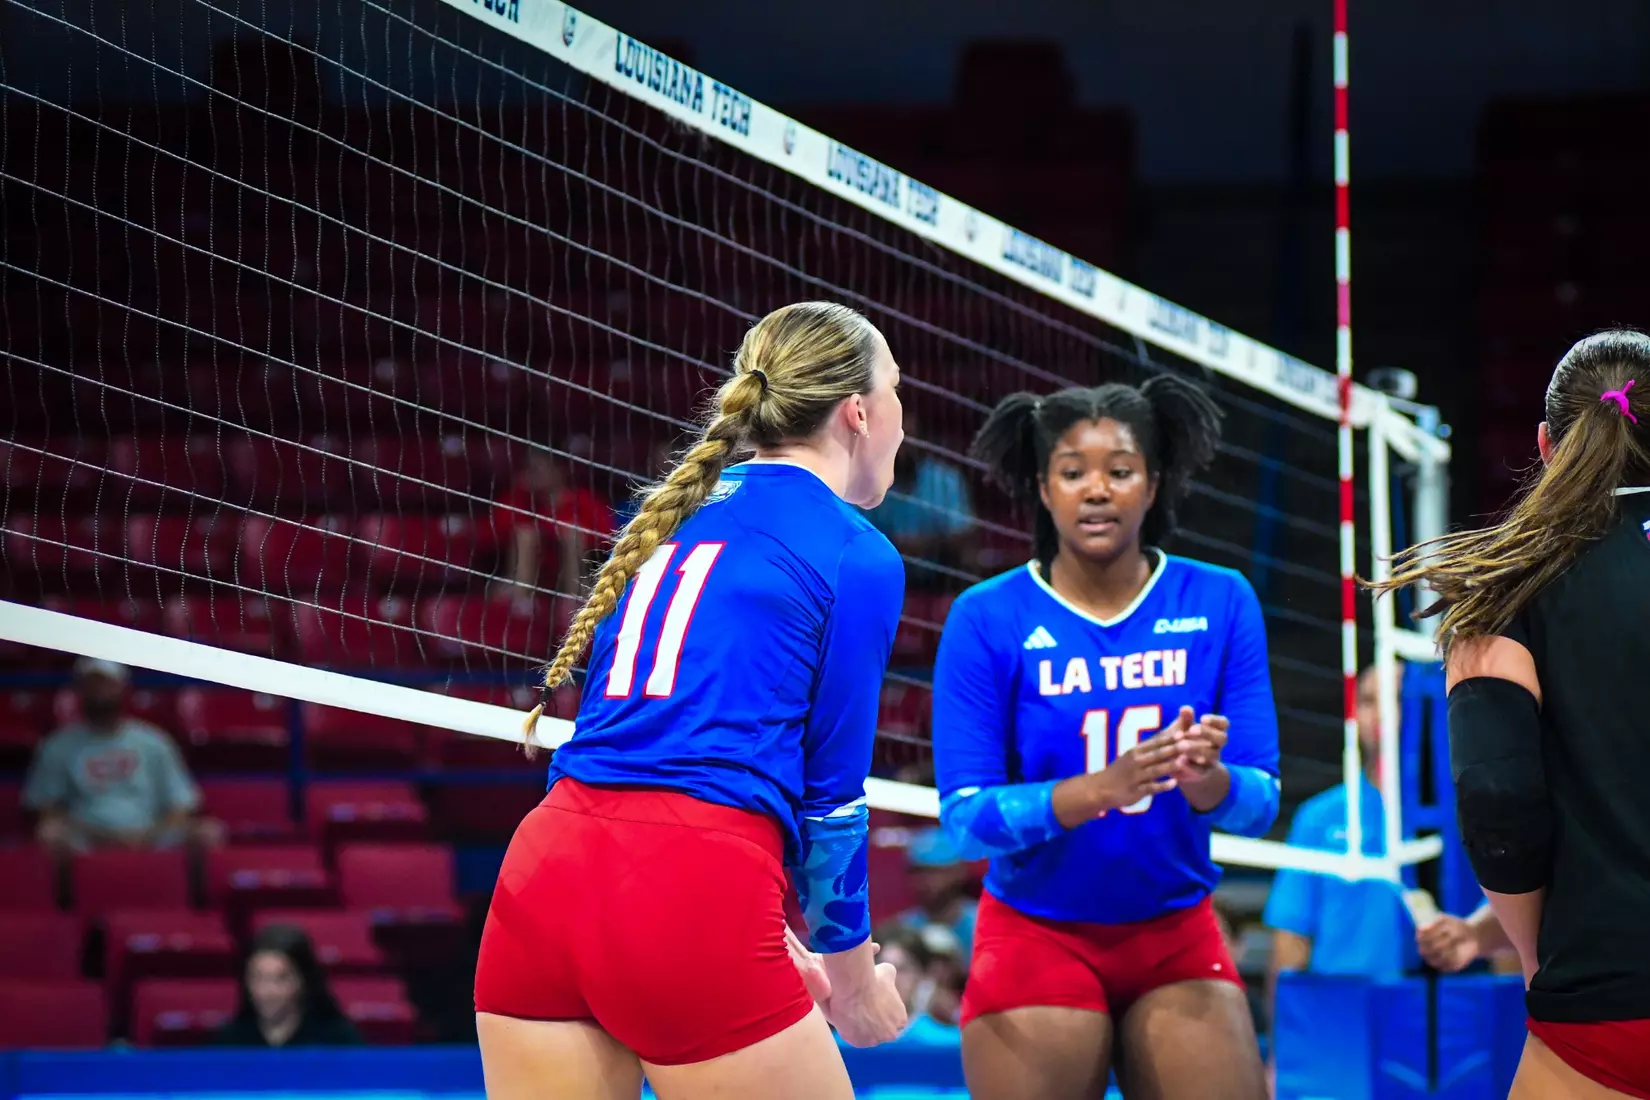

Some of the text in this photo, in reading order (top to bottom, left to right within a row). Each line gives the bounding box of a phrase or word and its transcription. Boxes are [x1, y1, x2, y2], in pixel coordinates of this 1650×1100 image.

[615, 31, 751, 136] LOUISIANA TECH
[604, 541, 727, 700] 11
[1039, 648, 1187, 696] LA TECH
